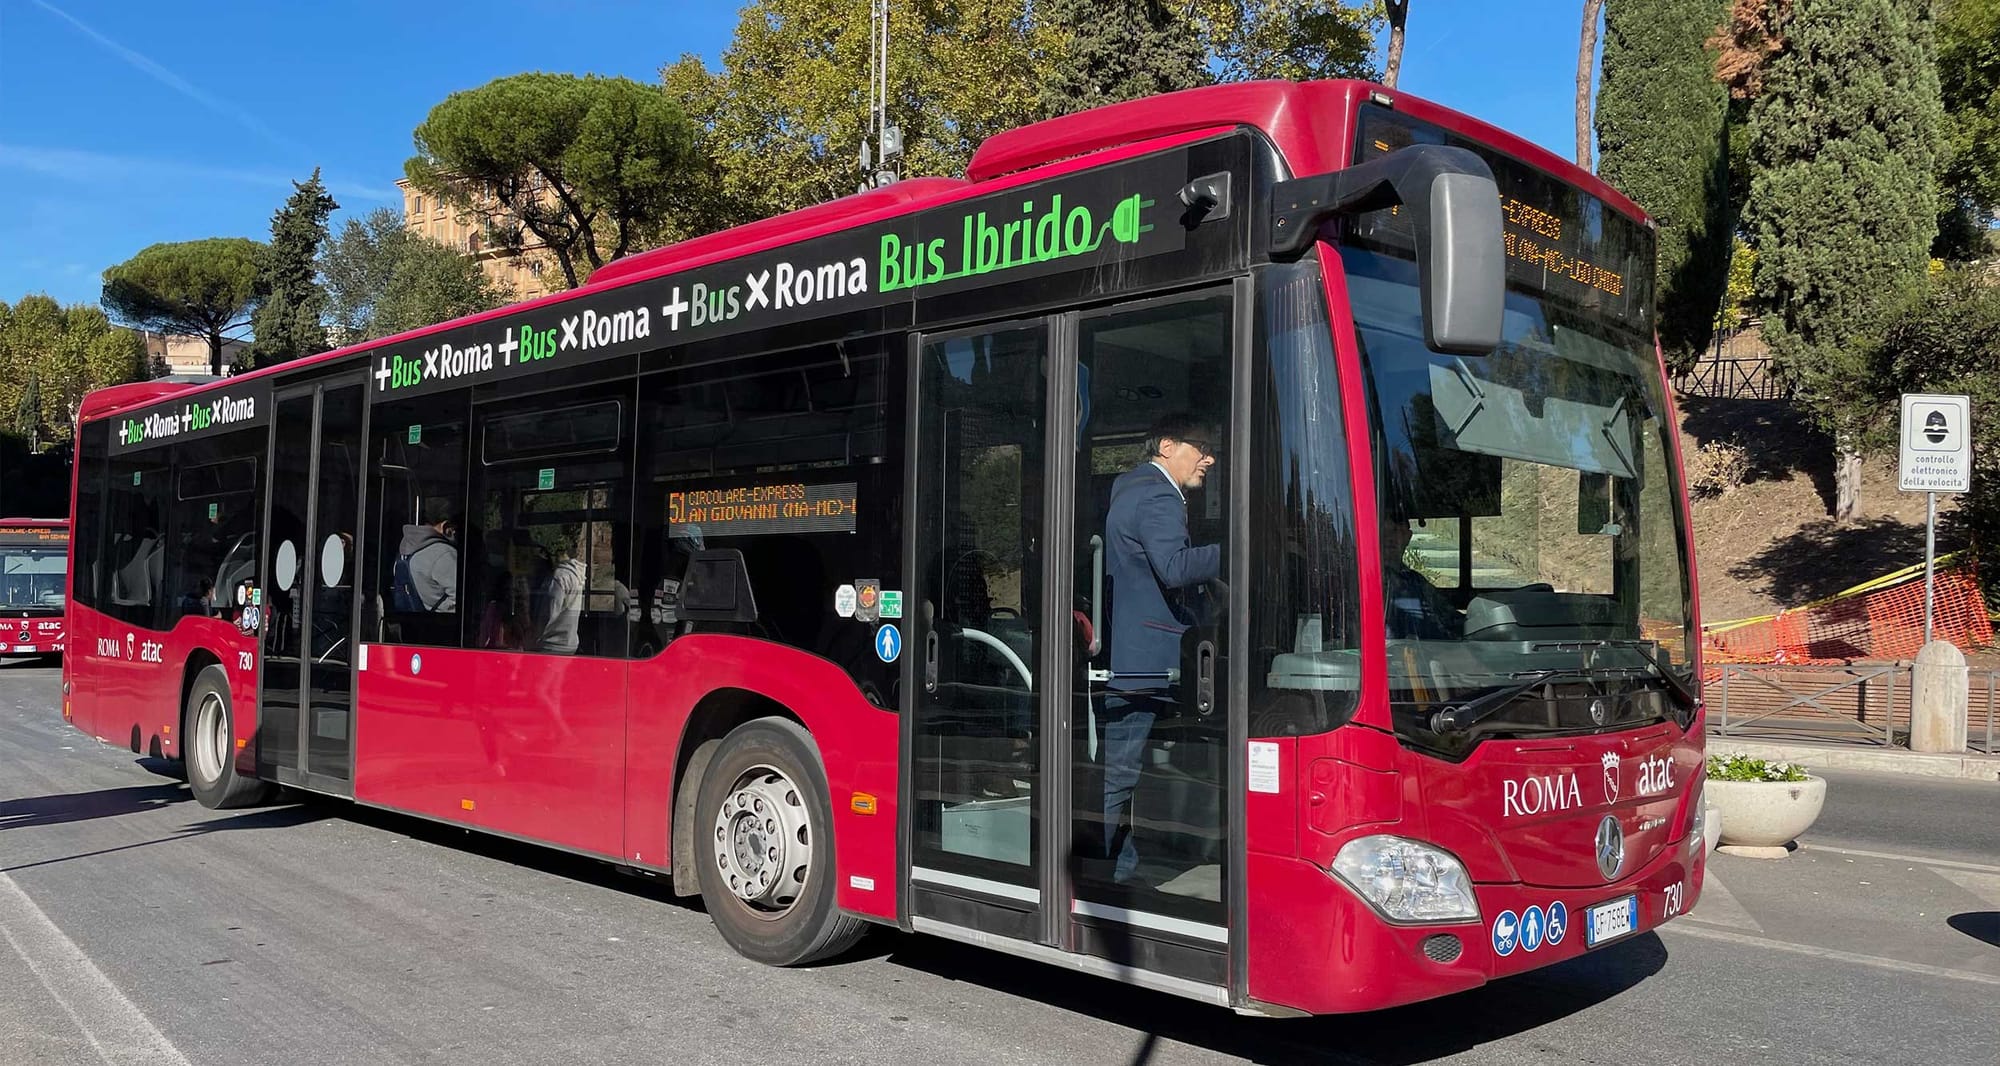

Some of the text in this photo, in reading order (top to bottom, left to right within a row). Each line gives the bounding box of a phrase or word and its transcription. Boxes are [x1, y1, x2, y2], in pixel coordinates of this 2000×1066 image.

[879, 194, 1092, 292] Bus Ibrido
[1915, 455, 1955, 464] controllo
[1911, 466, 1958, 475] elettronico
[1903, 477, 1925, 486] della
[689, 484, 805, 506] CIRCOLARE-EXPRESS
[669, 492, 686, 524] 51
[689, 507, 707, 522] AN
[711, 503, 778, 522] GIOVANNI
[38, 621, 61, 630] atac
[97, 637, 163, 663] ROMA atac
[238, 651, 253, 671] 730
[1503, 772, 1583, 817] ROMA
[1638, 754, 1675, 796] atac
[1663, 881, 1683, 919] 730
